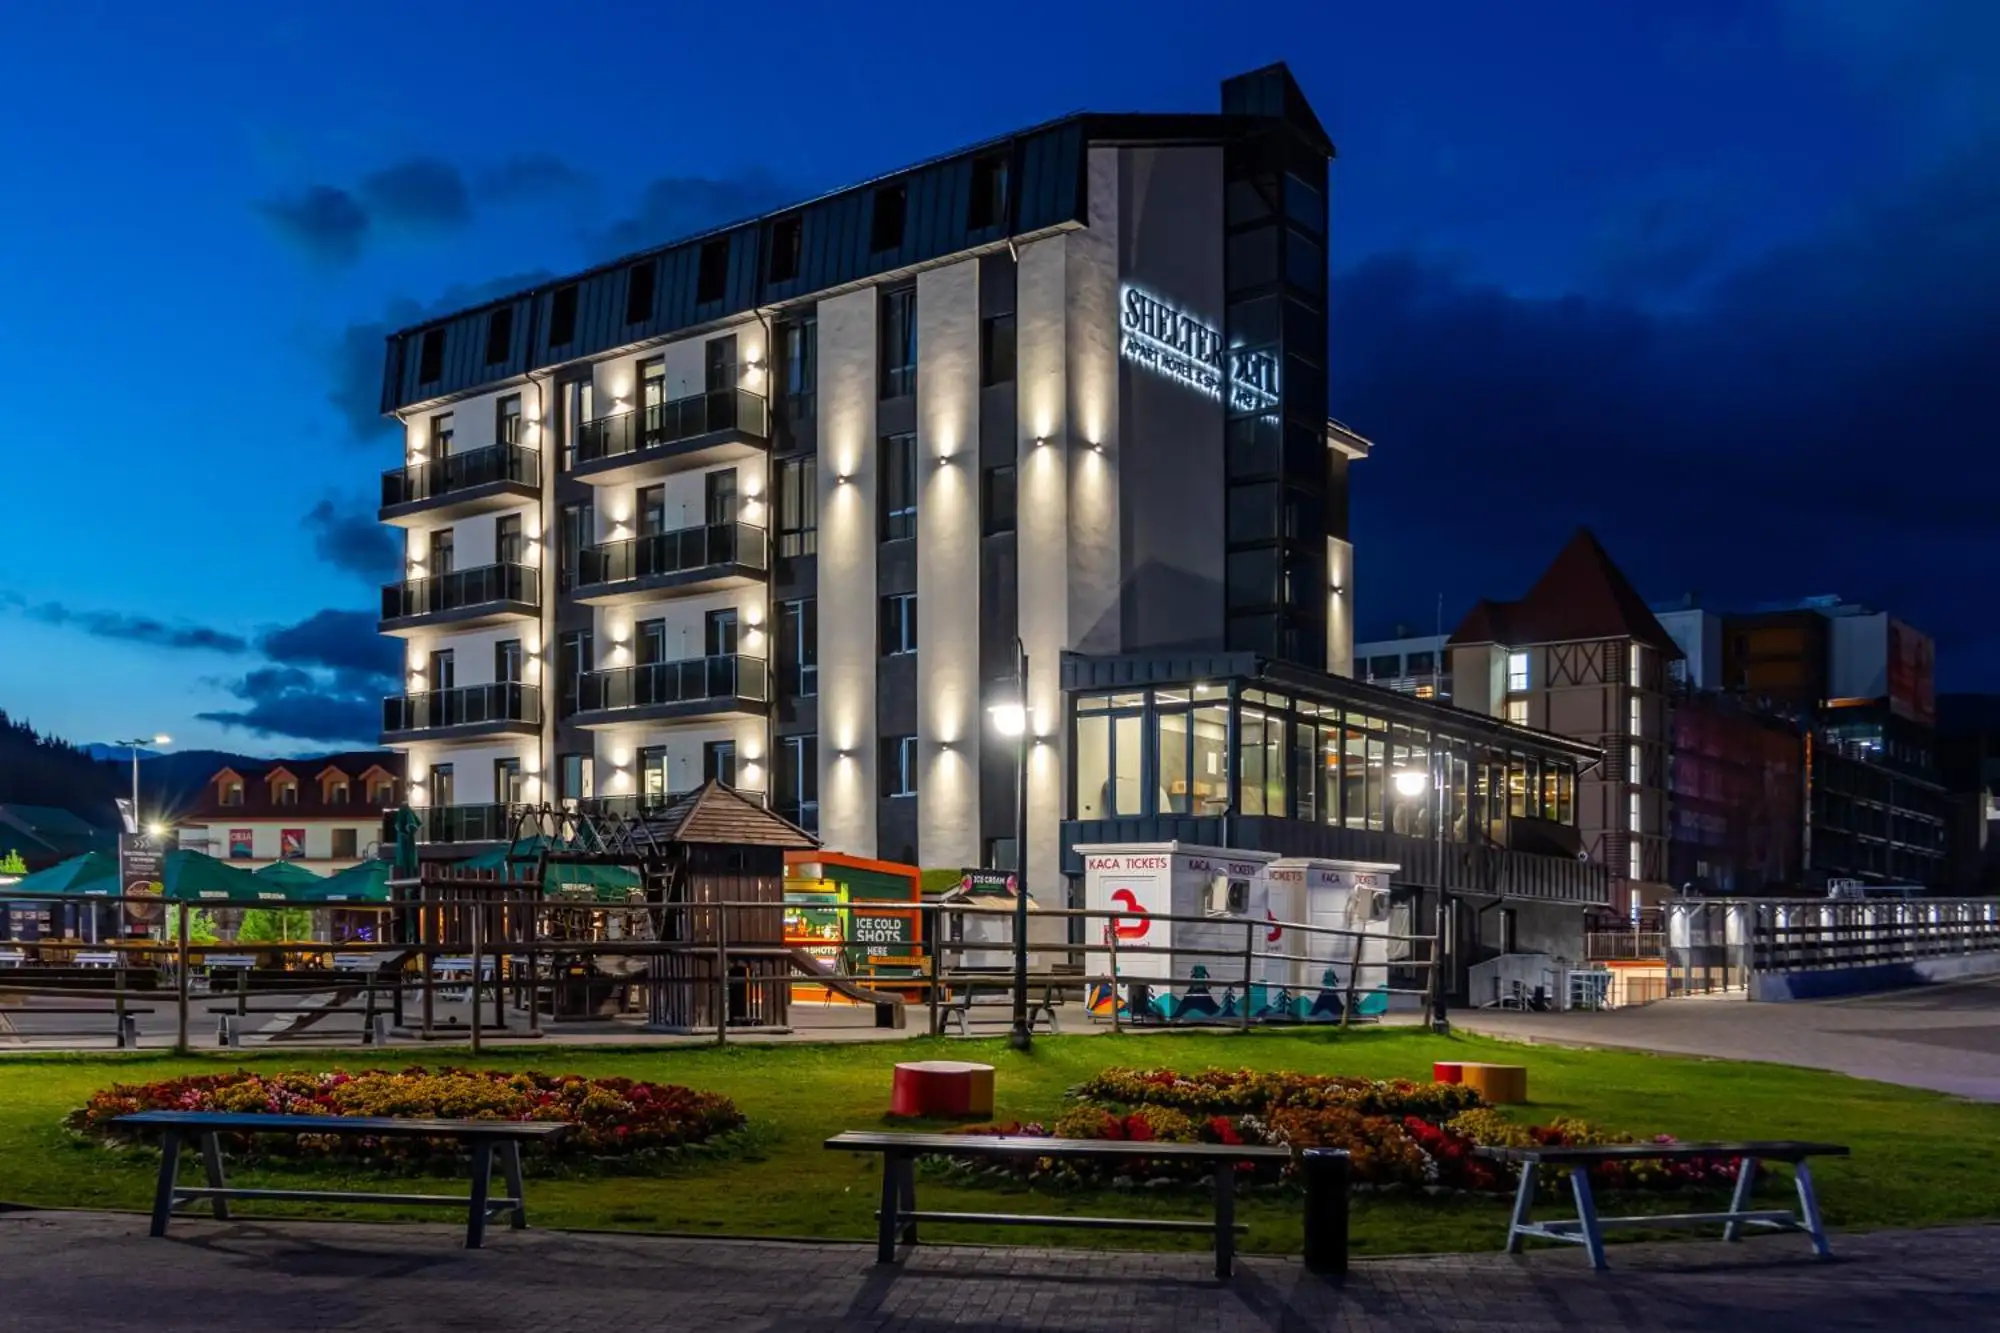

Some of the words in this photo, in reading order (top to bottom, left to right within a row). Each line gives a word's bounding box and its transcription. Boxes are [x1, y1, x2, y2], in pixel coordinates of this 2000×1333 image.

[1125, 288, 1224, 370] SHELTER
[1162, 354, 1192, 380] HOTEL
[1125, 857, 1168, 870] TICKETS
[1228, 863, 1256, 876] TICKETS
[856, 918, 873, 930] ICE
[874, 918, 902, 931] COLD
[856, 930, 901, 942] SHOTS
[867, 946, 889, 957] HERE
